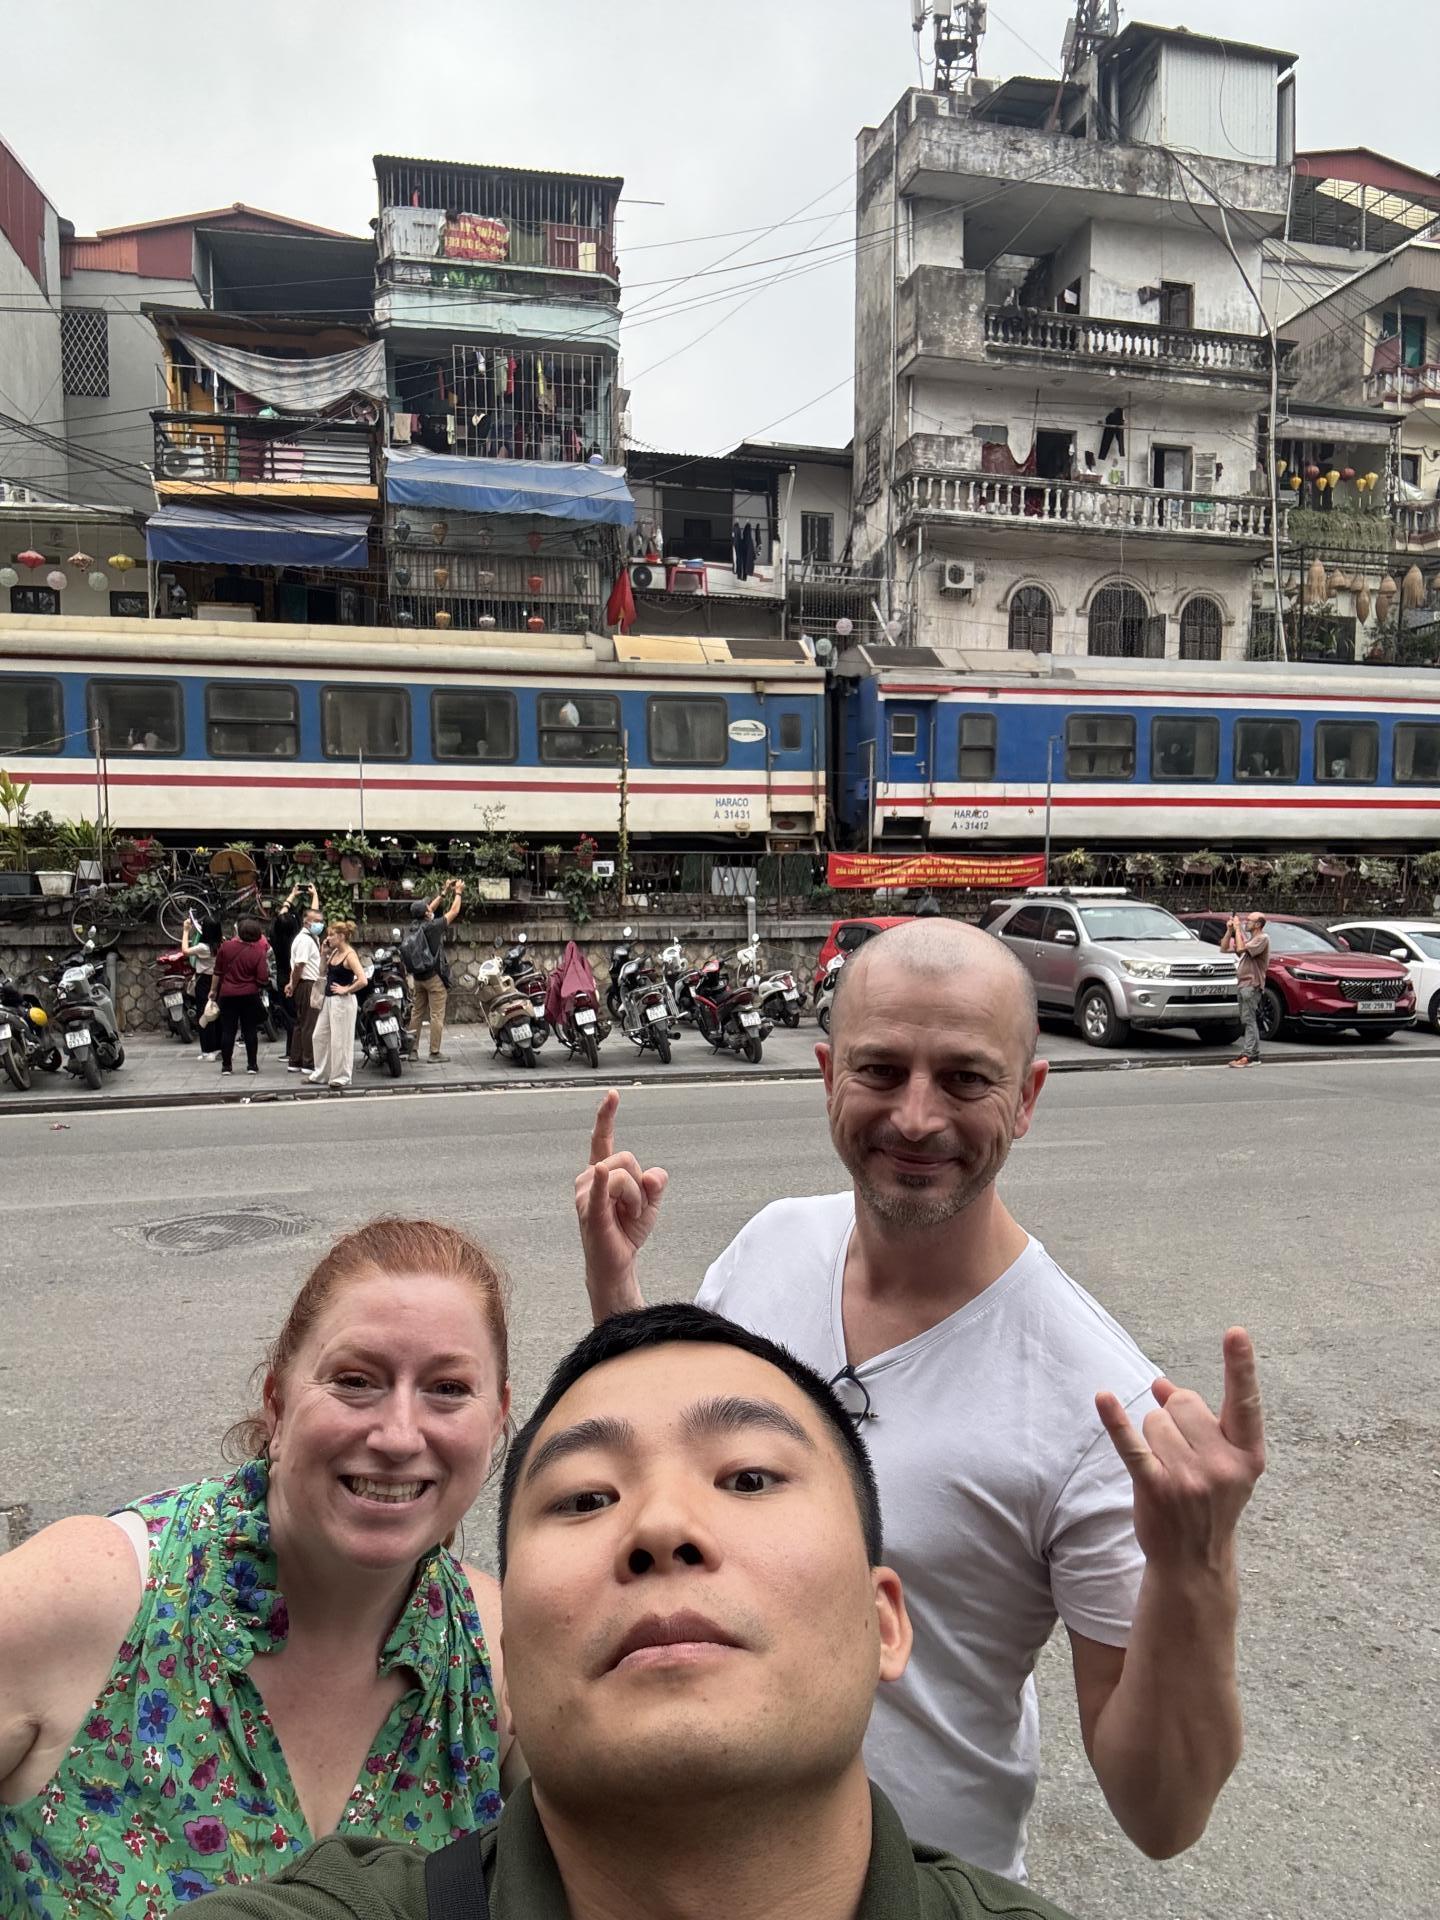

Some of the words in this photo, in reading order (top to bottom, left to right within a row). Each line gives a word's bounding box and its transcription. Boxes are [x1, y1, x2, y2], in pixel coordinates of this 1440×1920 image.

[715, 797, 749, 807] HARACO
[713, 810, 720, 819] A
[724, 810, 750, 819] 31431
[954, 809, 989, 819] HARACO
[965, 821, 989, 830] 31412
